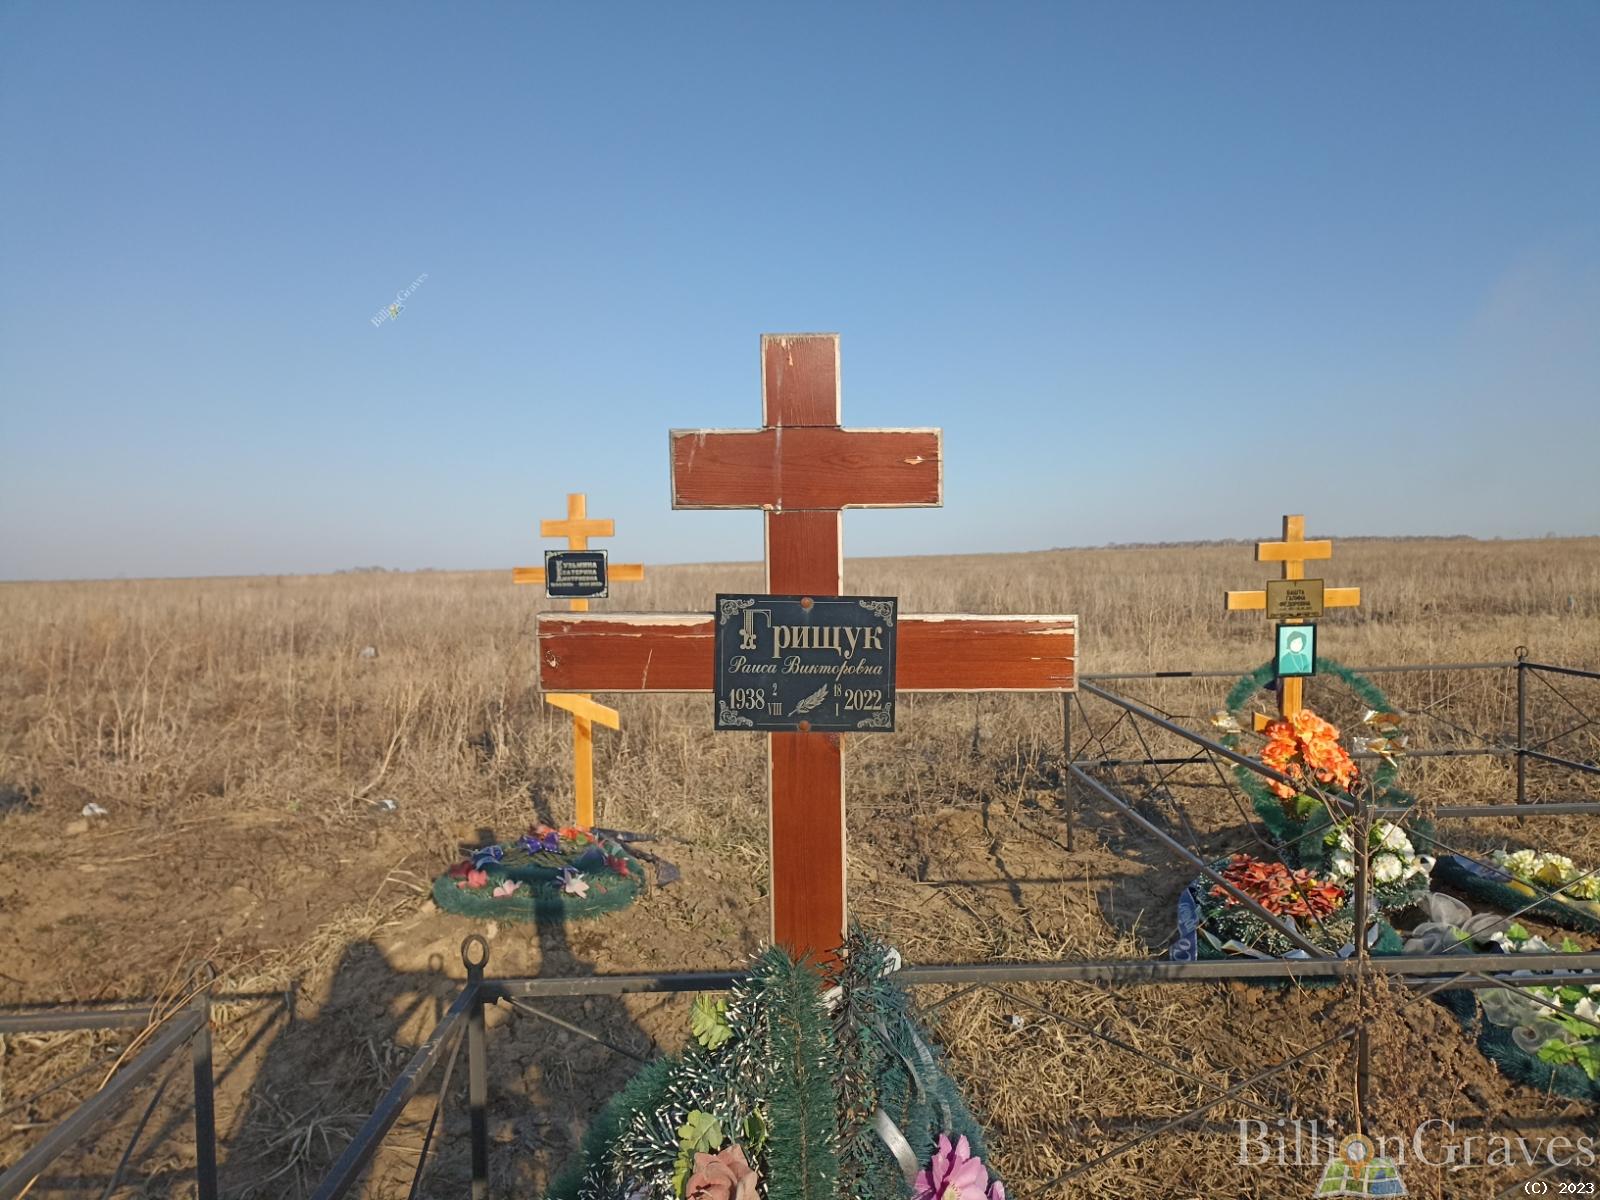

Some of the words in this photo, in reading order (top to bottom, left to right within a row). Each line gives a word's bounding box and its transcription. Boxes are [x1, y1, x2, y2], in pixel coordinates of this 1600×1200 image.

[739, 609, 883, 658] Грищук
[728, 655, 777, 674] Раиса
[781, 655, 883, 681] Викторовна
[728, 687, 765, 710] 1938
[772, 684, 778, 696] 2
[833, 684, 842, 697] 18
[844, 689, 882, 711] 2022
[767, 702, 782, 716] VIII
